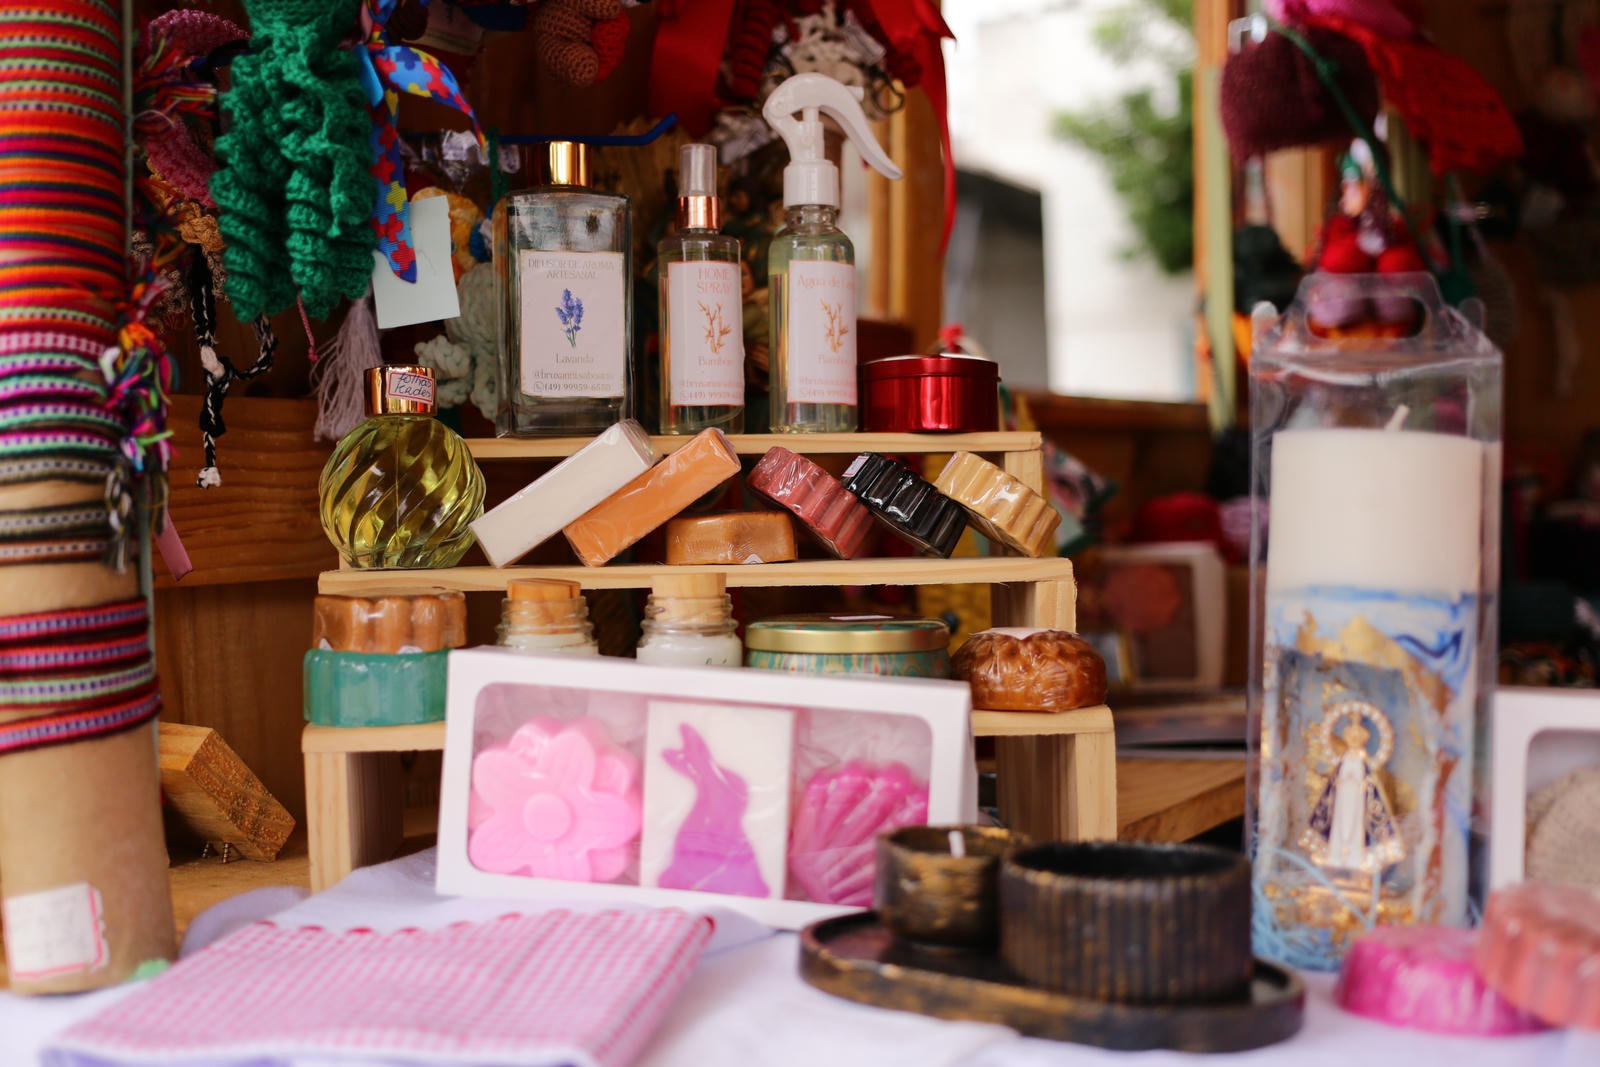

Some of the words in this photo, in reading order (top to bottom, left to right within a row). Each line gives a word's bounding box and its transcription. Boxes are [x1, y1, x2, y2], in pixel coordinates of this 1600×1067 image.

[546, 269, 598, 280] ARTESANAL
[697, 267, 731, 280] HOME
[696, 281, 731, 296] SPRAY
[555, 352, 595, 364] Lavanda
[544, 383, 561, 392] (49)
